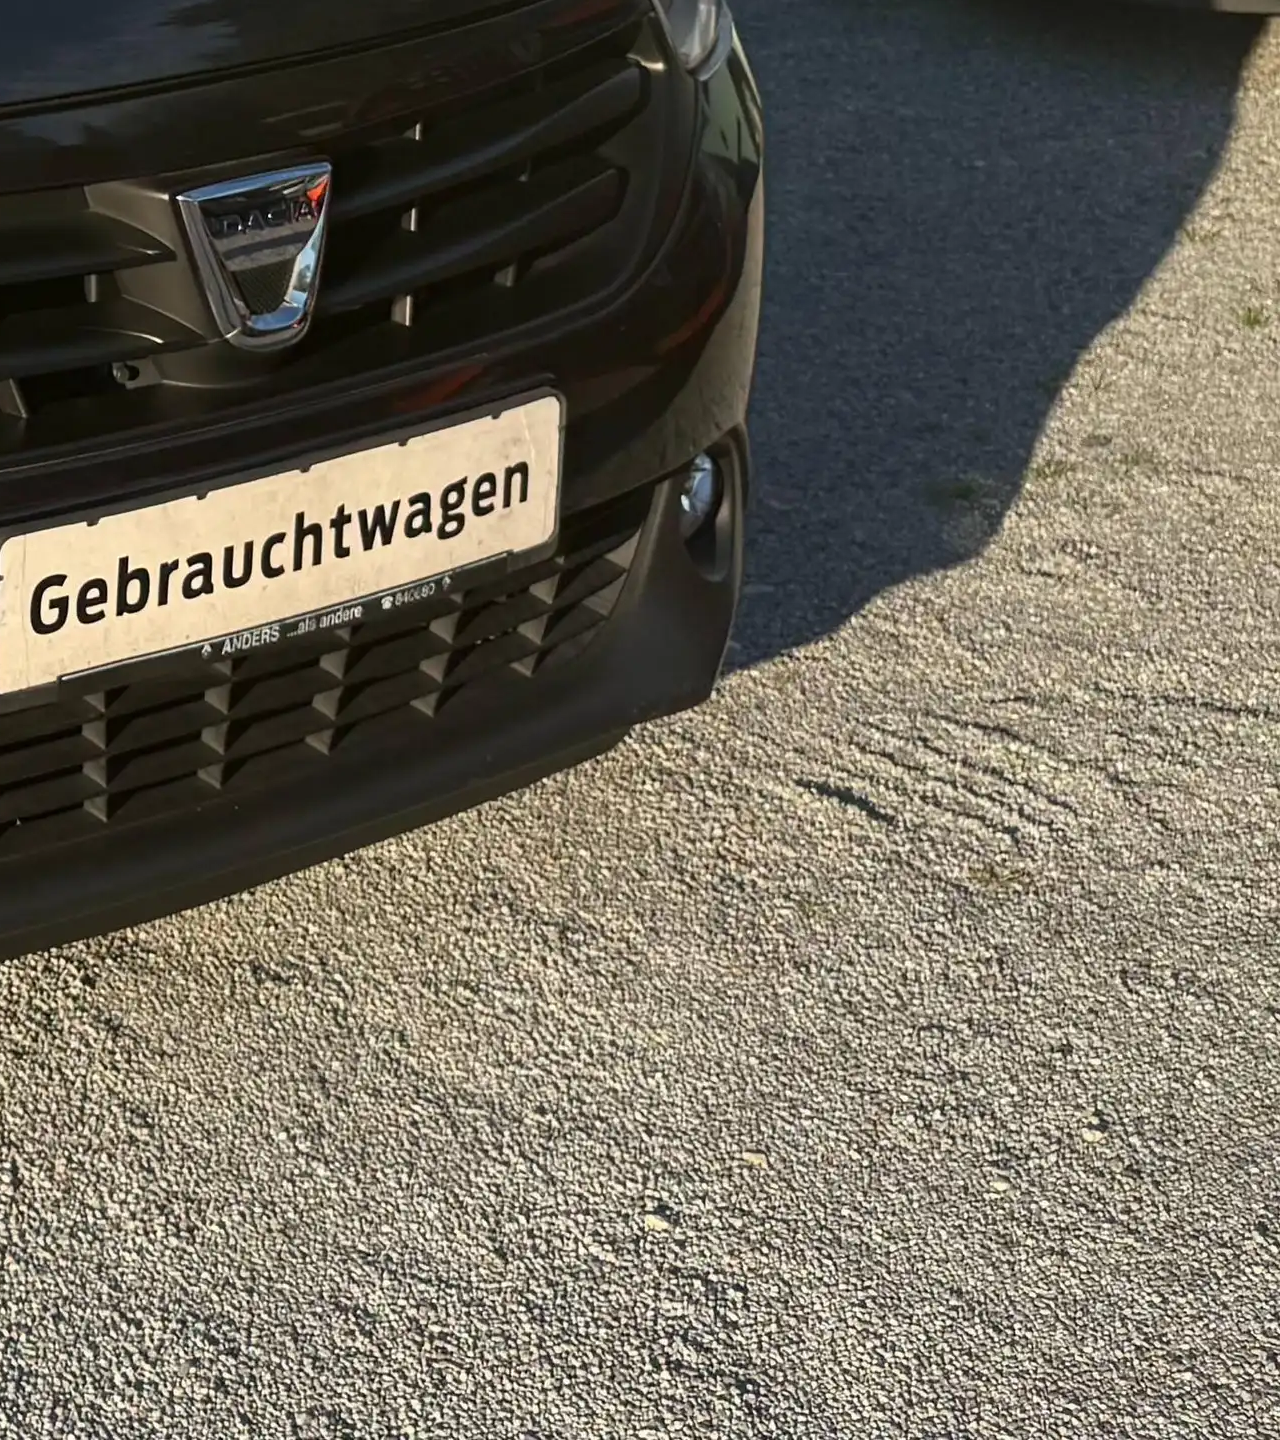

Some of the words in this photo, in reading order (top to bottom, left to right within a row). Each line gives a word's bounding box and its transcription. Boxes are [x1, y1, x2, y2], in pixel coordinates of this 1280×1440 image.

[30, 459, 529, 635] Gebrauchtwagen
[221, 625, 280, 655] ANDERS
[319, 604, 363, 628] andere
